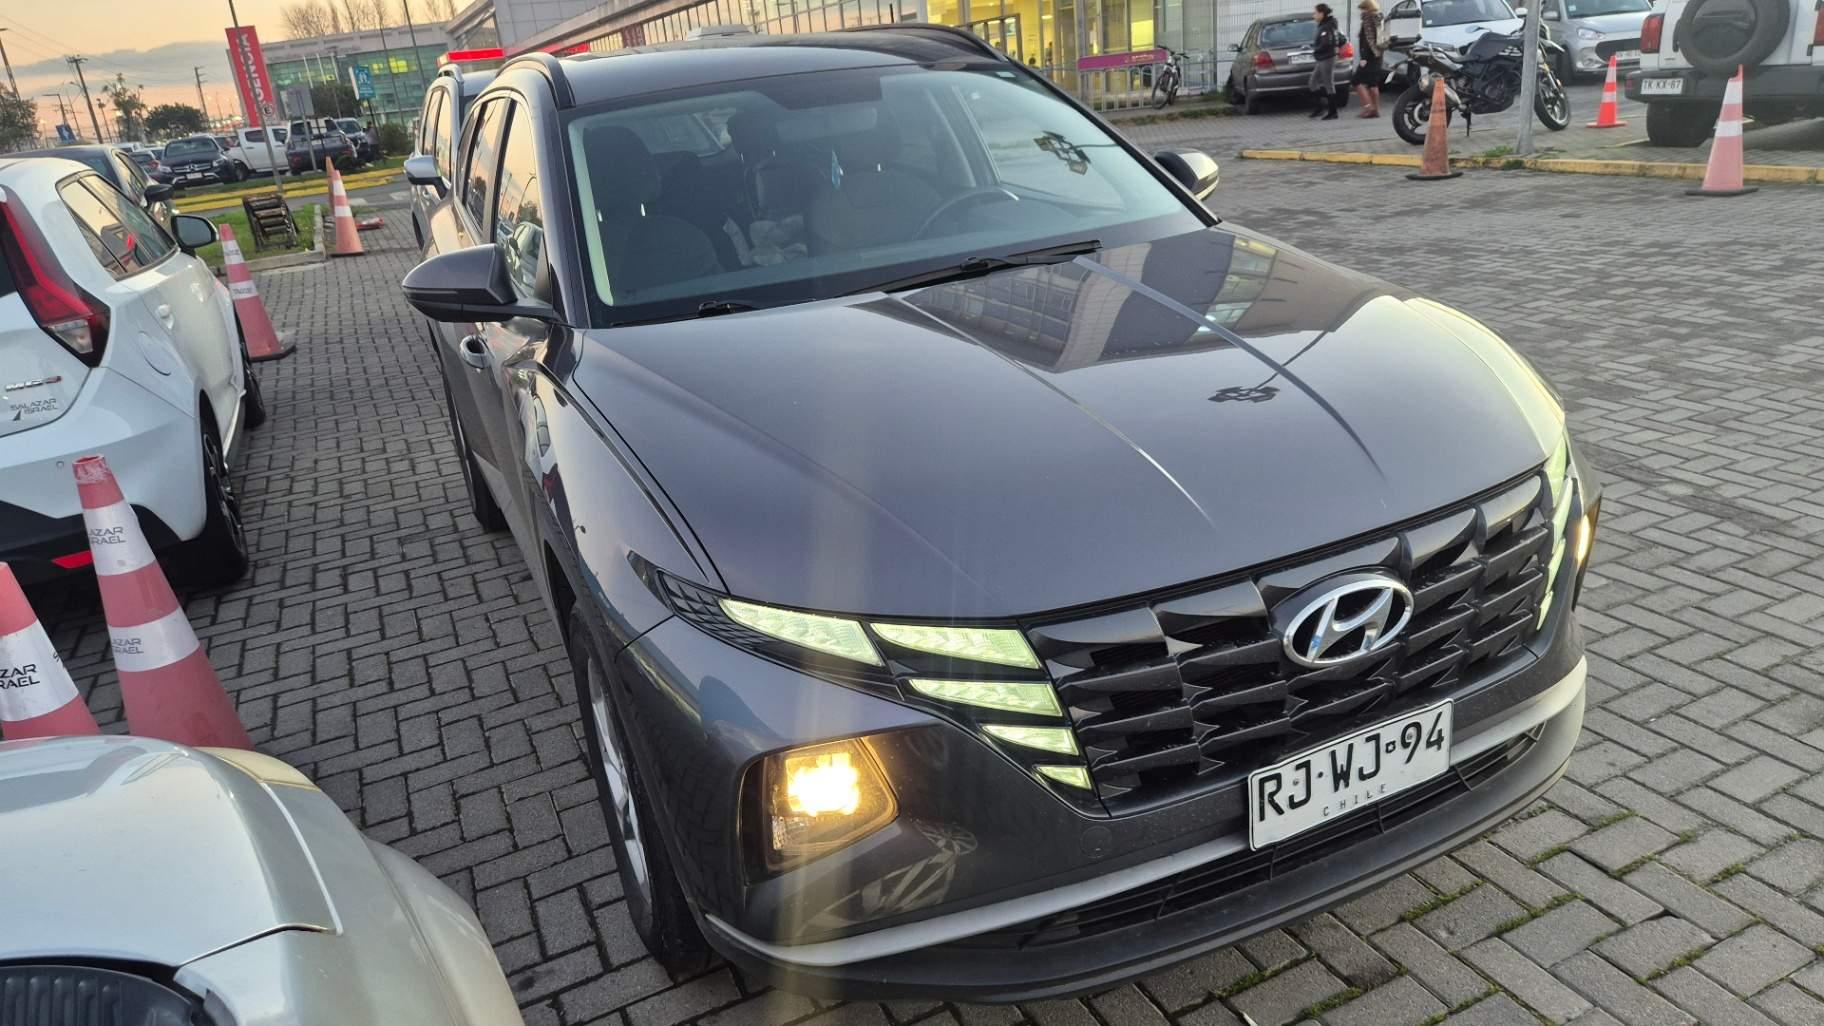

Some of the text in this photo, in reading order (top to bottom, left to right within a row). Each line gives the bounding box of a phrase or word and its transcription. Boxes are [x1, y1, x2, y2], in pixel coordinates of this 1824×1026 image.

[10, 398, 57, 411] SALAZAR
[23, 404, 58, 414] ISRAEL
[1323, 783, 1386, 817] CHILE
